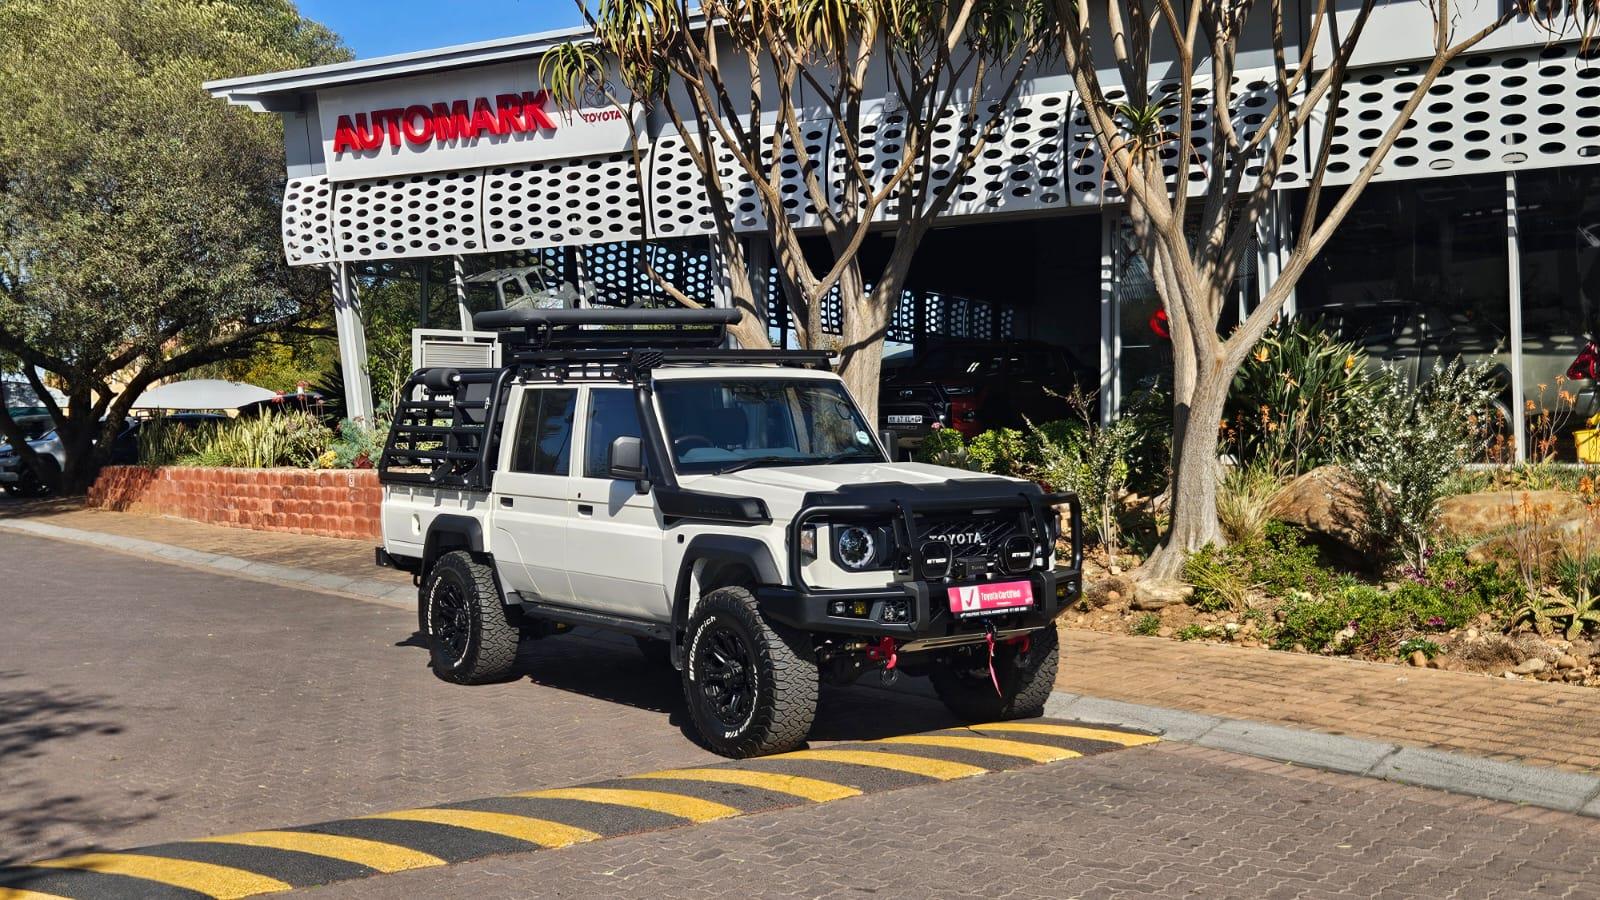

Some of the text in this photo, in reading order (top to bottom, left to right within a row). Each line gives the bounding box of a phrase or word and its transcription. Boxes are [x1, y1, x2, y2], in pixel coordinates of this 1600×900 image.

[333, 89, 558, 152] AUTOMARK
[583, 110, 622, 123] TOYOTA
[981, 589, 1020, 601] Toyota Certified
[689, 616, 716, 681] BFGoodrich
